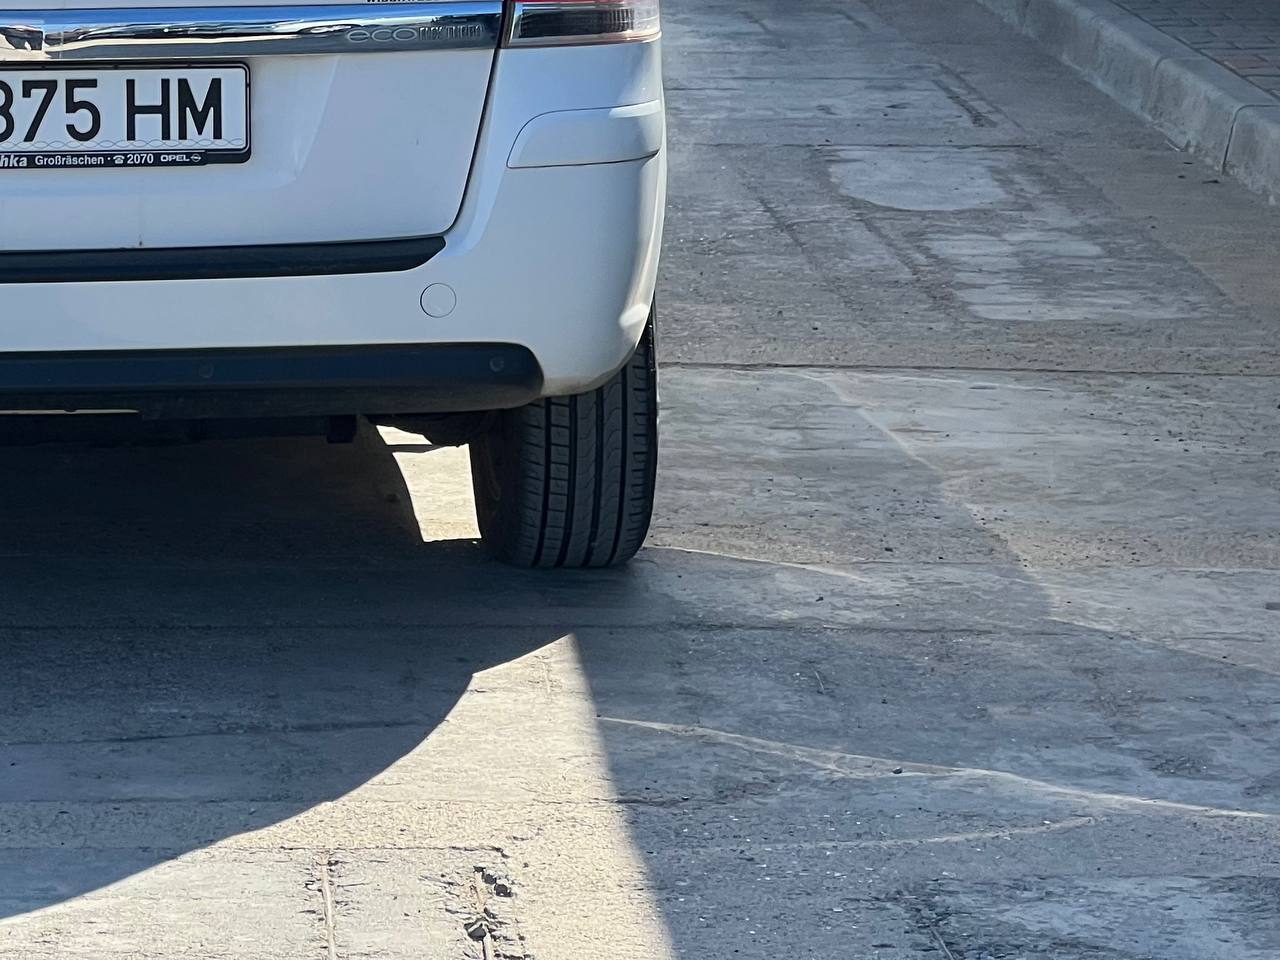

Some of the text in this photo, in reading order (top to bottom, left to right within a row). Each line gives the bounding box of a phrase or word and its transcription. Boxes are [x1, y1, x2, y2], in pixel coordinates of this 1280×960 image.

[126, 77, 223, 141] HM
[34, 155, 105, 166] Großräschen
[126, 153, 155, 165] 2070
[160, 154, 190, 163] OPEL
